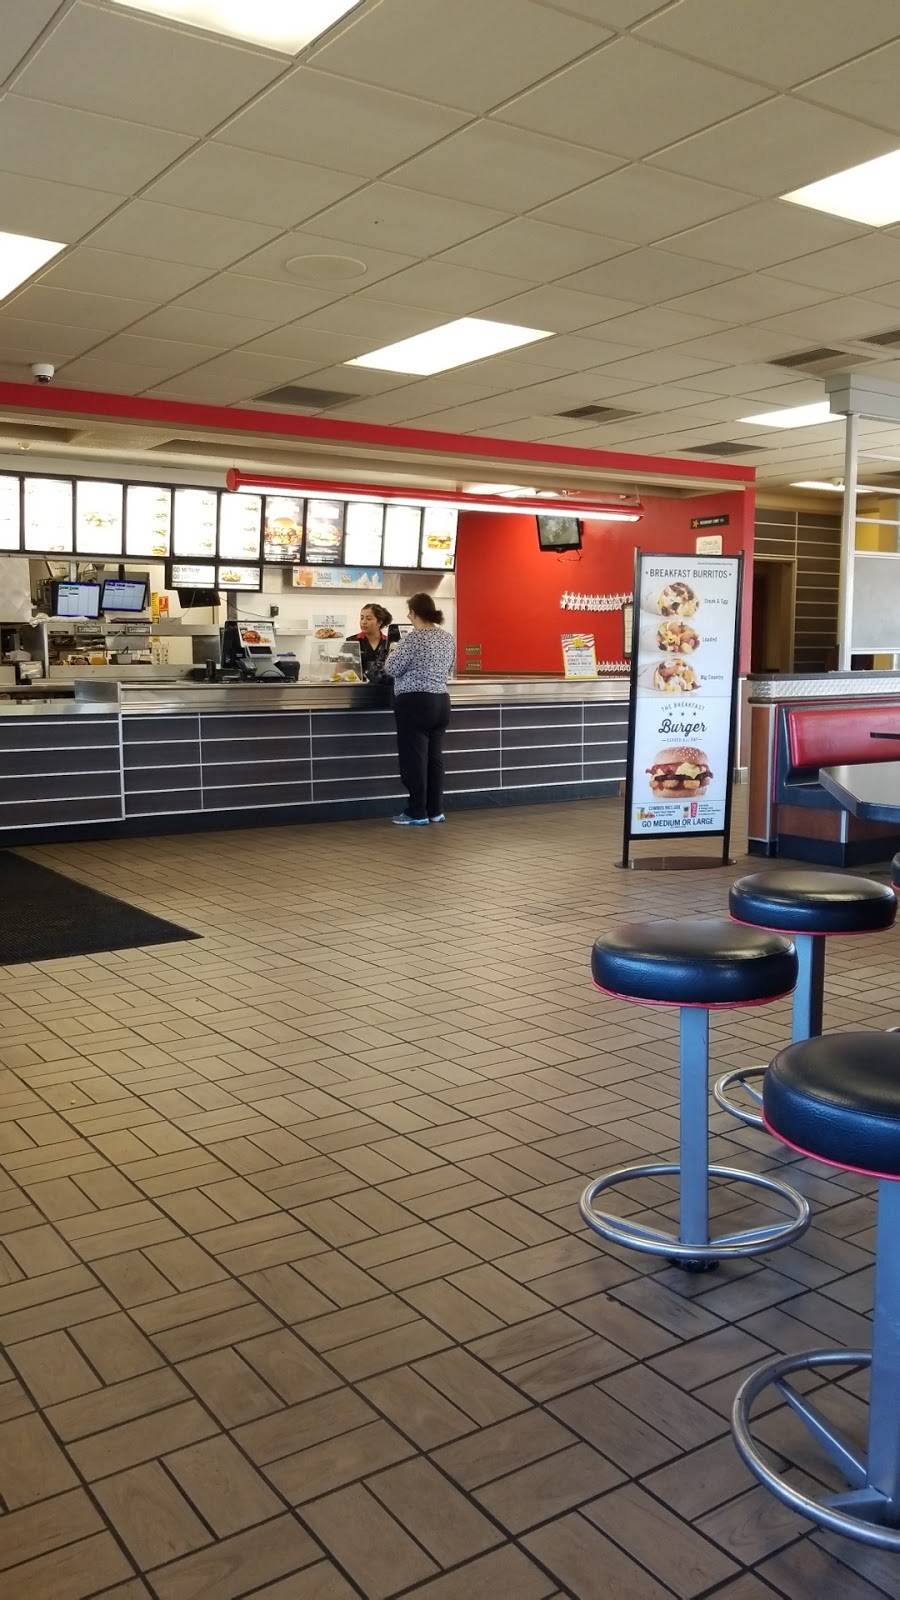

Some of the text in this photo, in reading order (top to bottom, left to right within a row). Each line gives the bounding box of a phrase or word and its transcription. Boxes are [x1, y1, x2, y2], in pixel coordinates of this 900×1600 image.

[649, 568, 728, 579] BREAKFAST BURRITOS
[674, 702, 705, 711] BREAKFAST
[658, 719, 706, 737] Burger
[653, 819, 680, 827] MEDIUM
